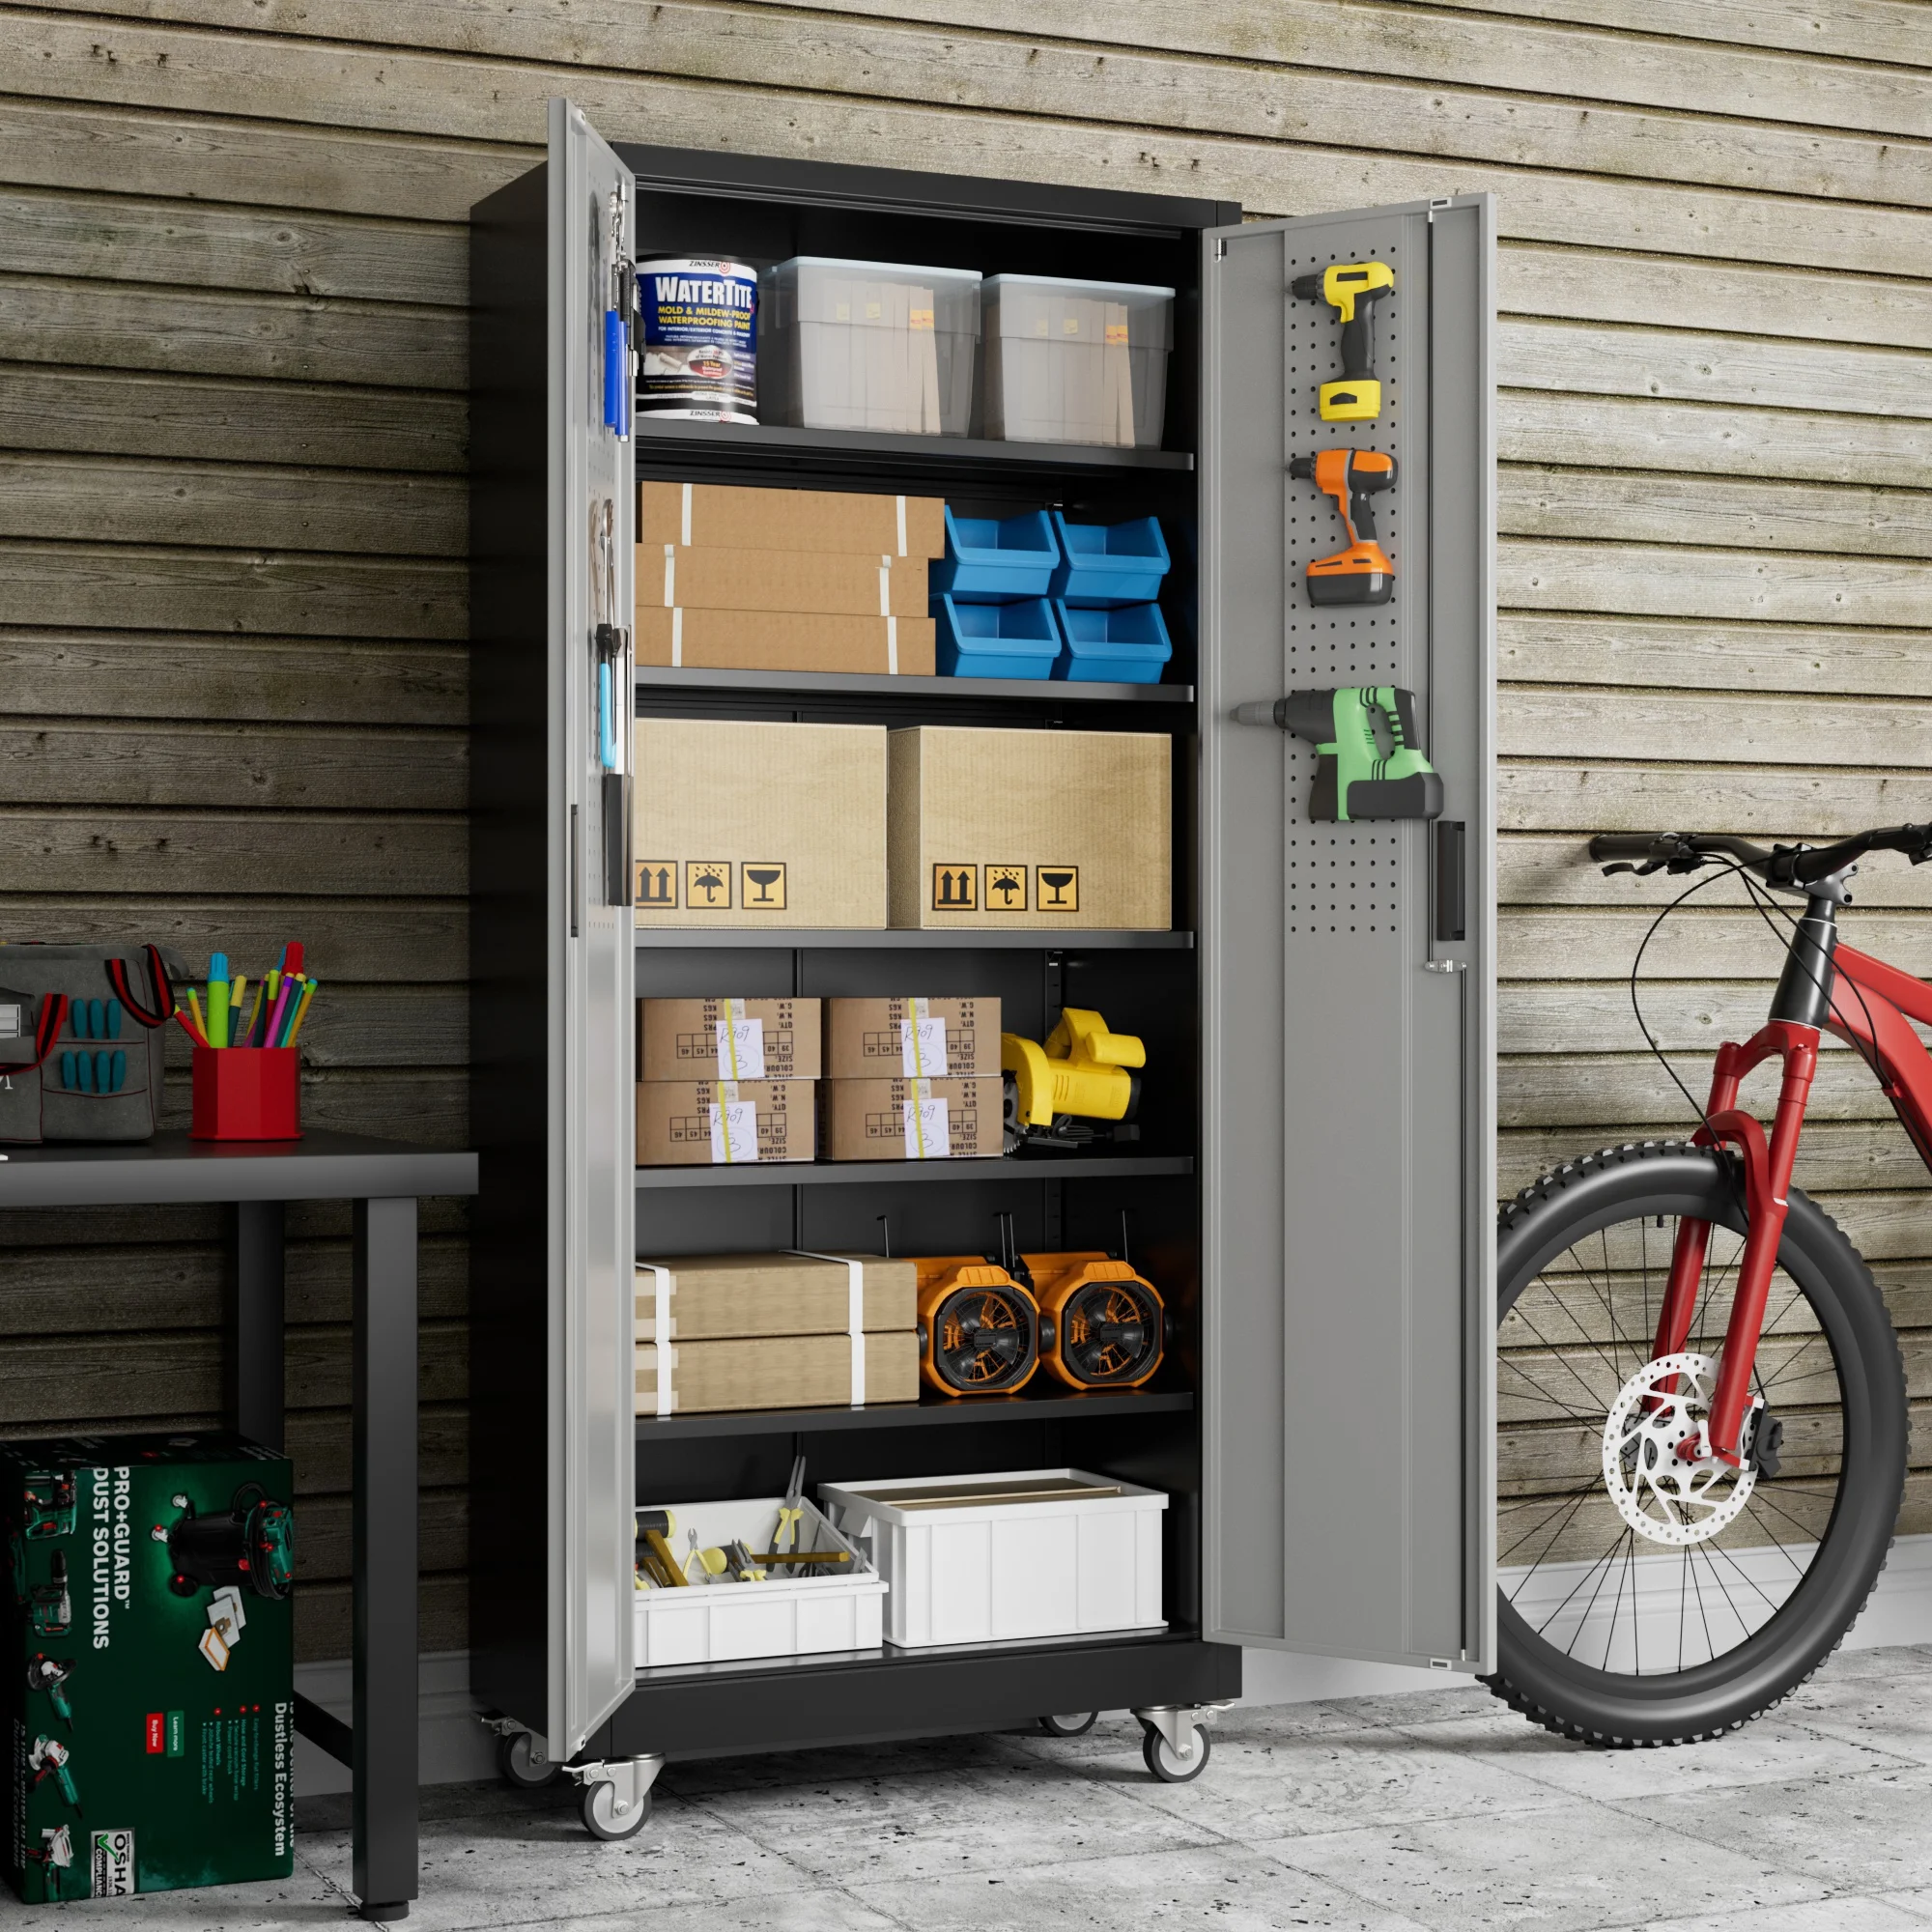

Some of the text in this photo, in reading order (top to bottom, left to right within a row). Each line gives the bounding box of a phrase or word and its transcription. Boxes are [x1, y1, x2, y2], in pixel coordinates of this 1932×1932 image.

[659, 317, 751, 330] WATERPROOFING PAINT
[696, 307, 751, 320] MILDEW-PROOF
[93, 1467, 109, 1649] DUST SOLUTIONS
[272, 1702, 287, 1857] Dustless Ecosystem
[115, 1834, 126, 1895] OSHA
